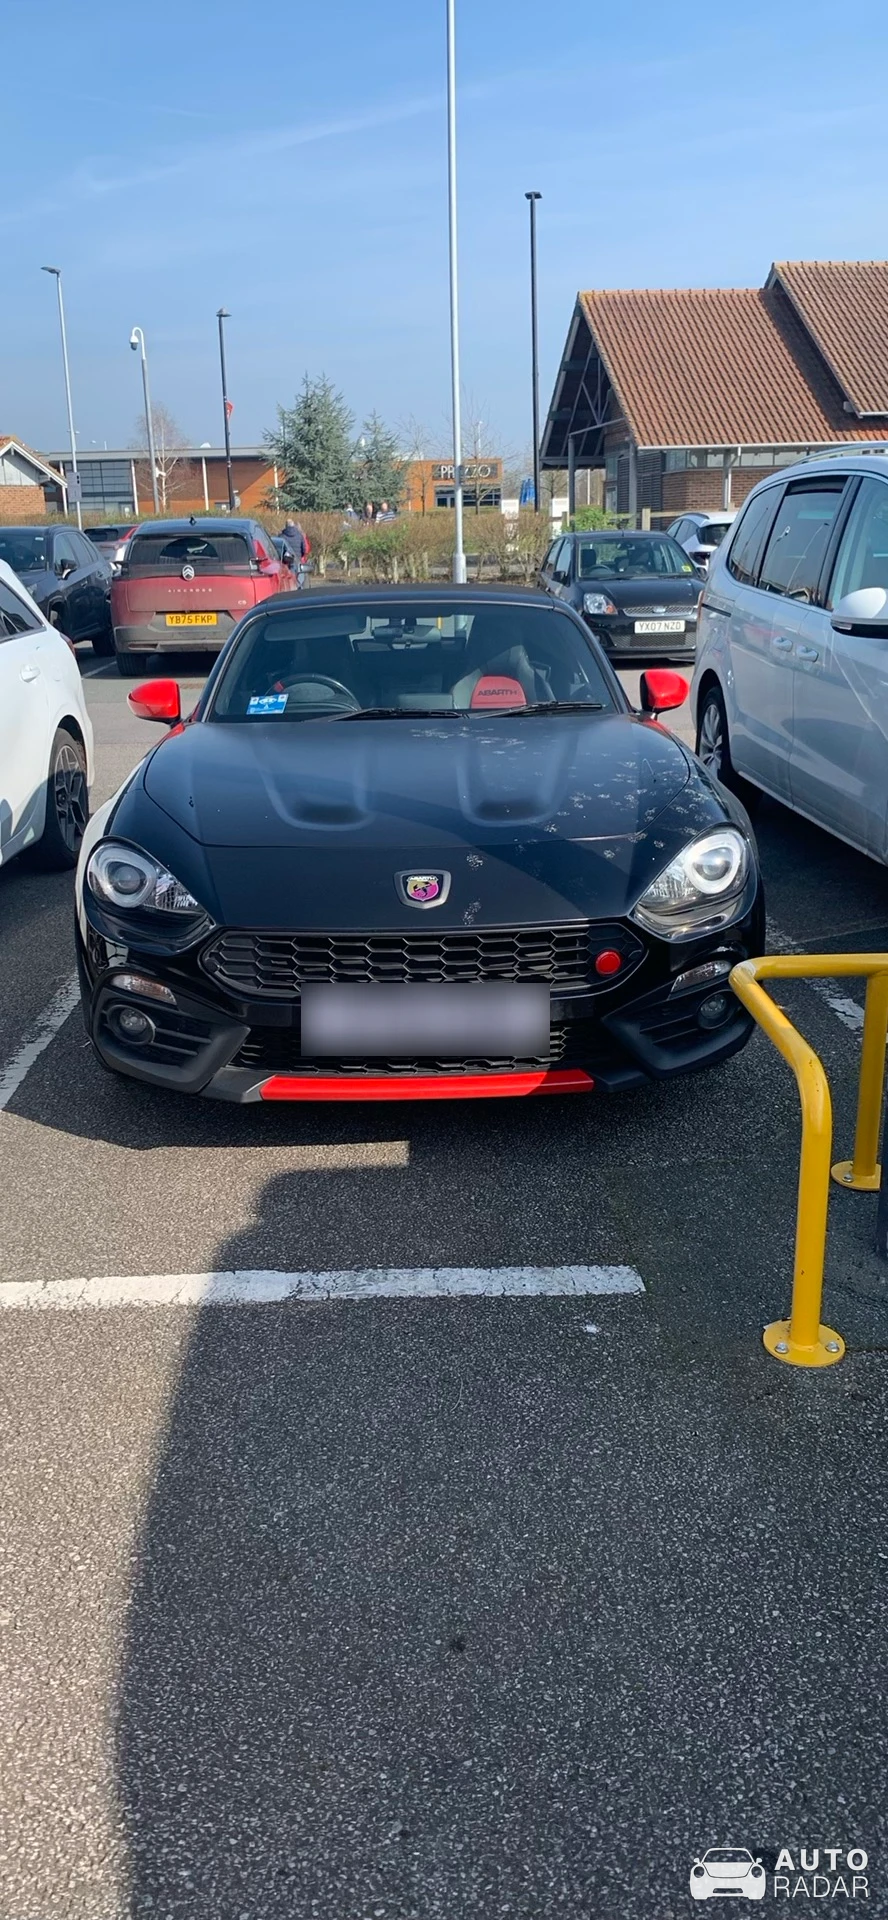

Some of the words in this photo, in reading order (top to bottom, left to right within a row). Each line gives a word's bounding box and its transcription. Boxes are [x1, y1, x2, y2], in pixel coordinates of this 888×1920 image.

[441, 464, 490, 478] PRZZO
[169, 615, 193, 625] YB75
[194, 615, 213, 624] FKP
[638, 622, 662, 632] YX07
[664, 621, 681, 631] NZD
[478, 688, 518, 696] ABARTH
